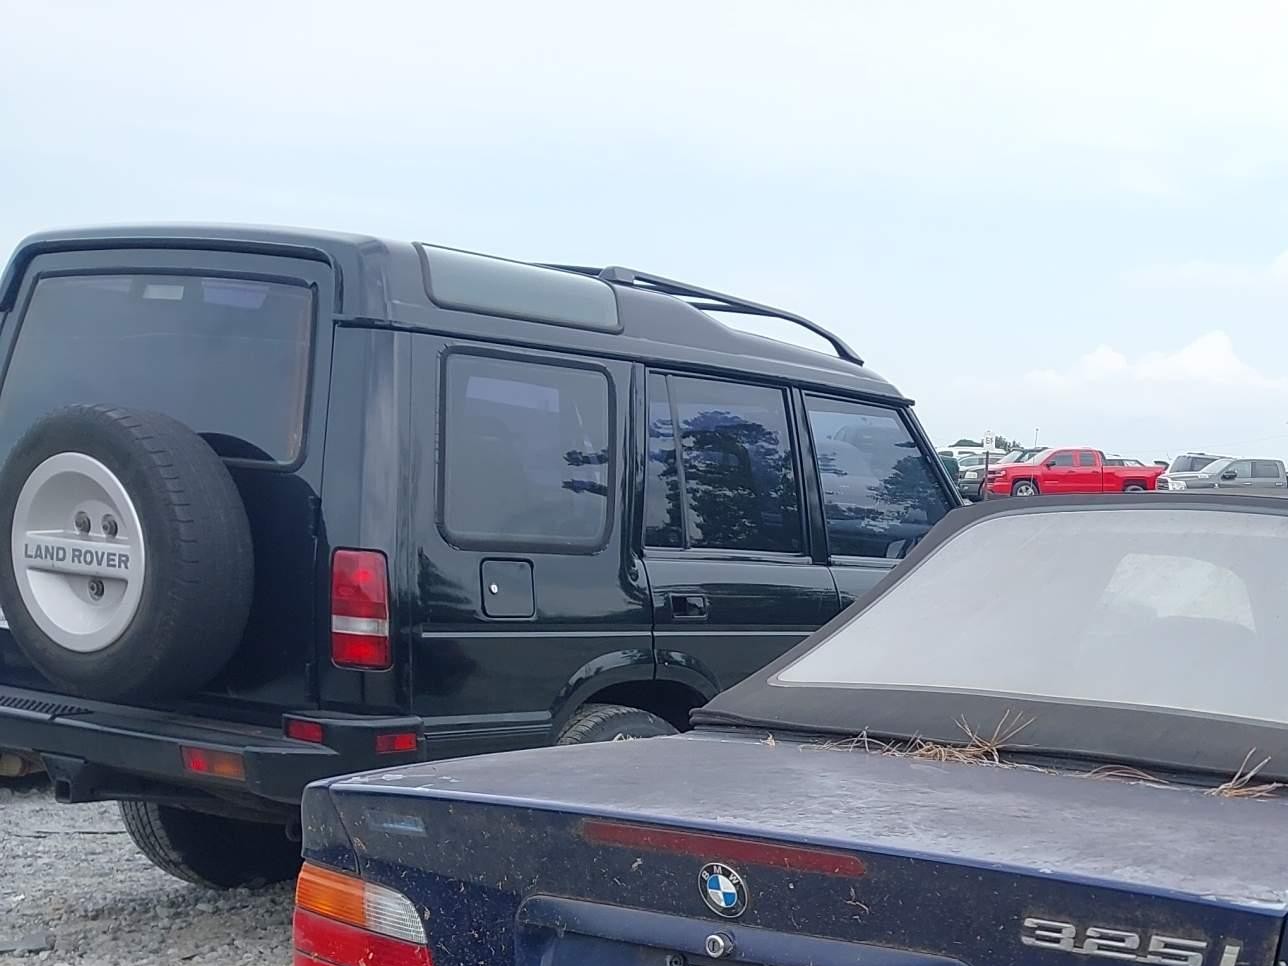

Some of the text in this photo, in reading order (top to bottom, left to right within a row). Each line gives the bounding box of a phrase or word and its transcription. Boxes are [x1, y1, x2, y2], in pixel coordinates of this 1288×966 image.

[24, 543, 130, 569] LAND ROVER
[701, 865, 740, 884] BMW
